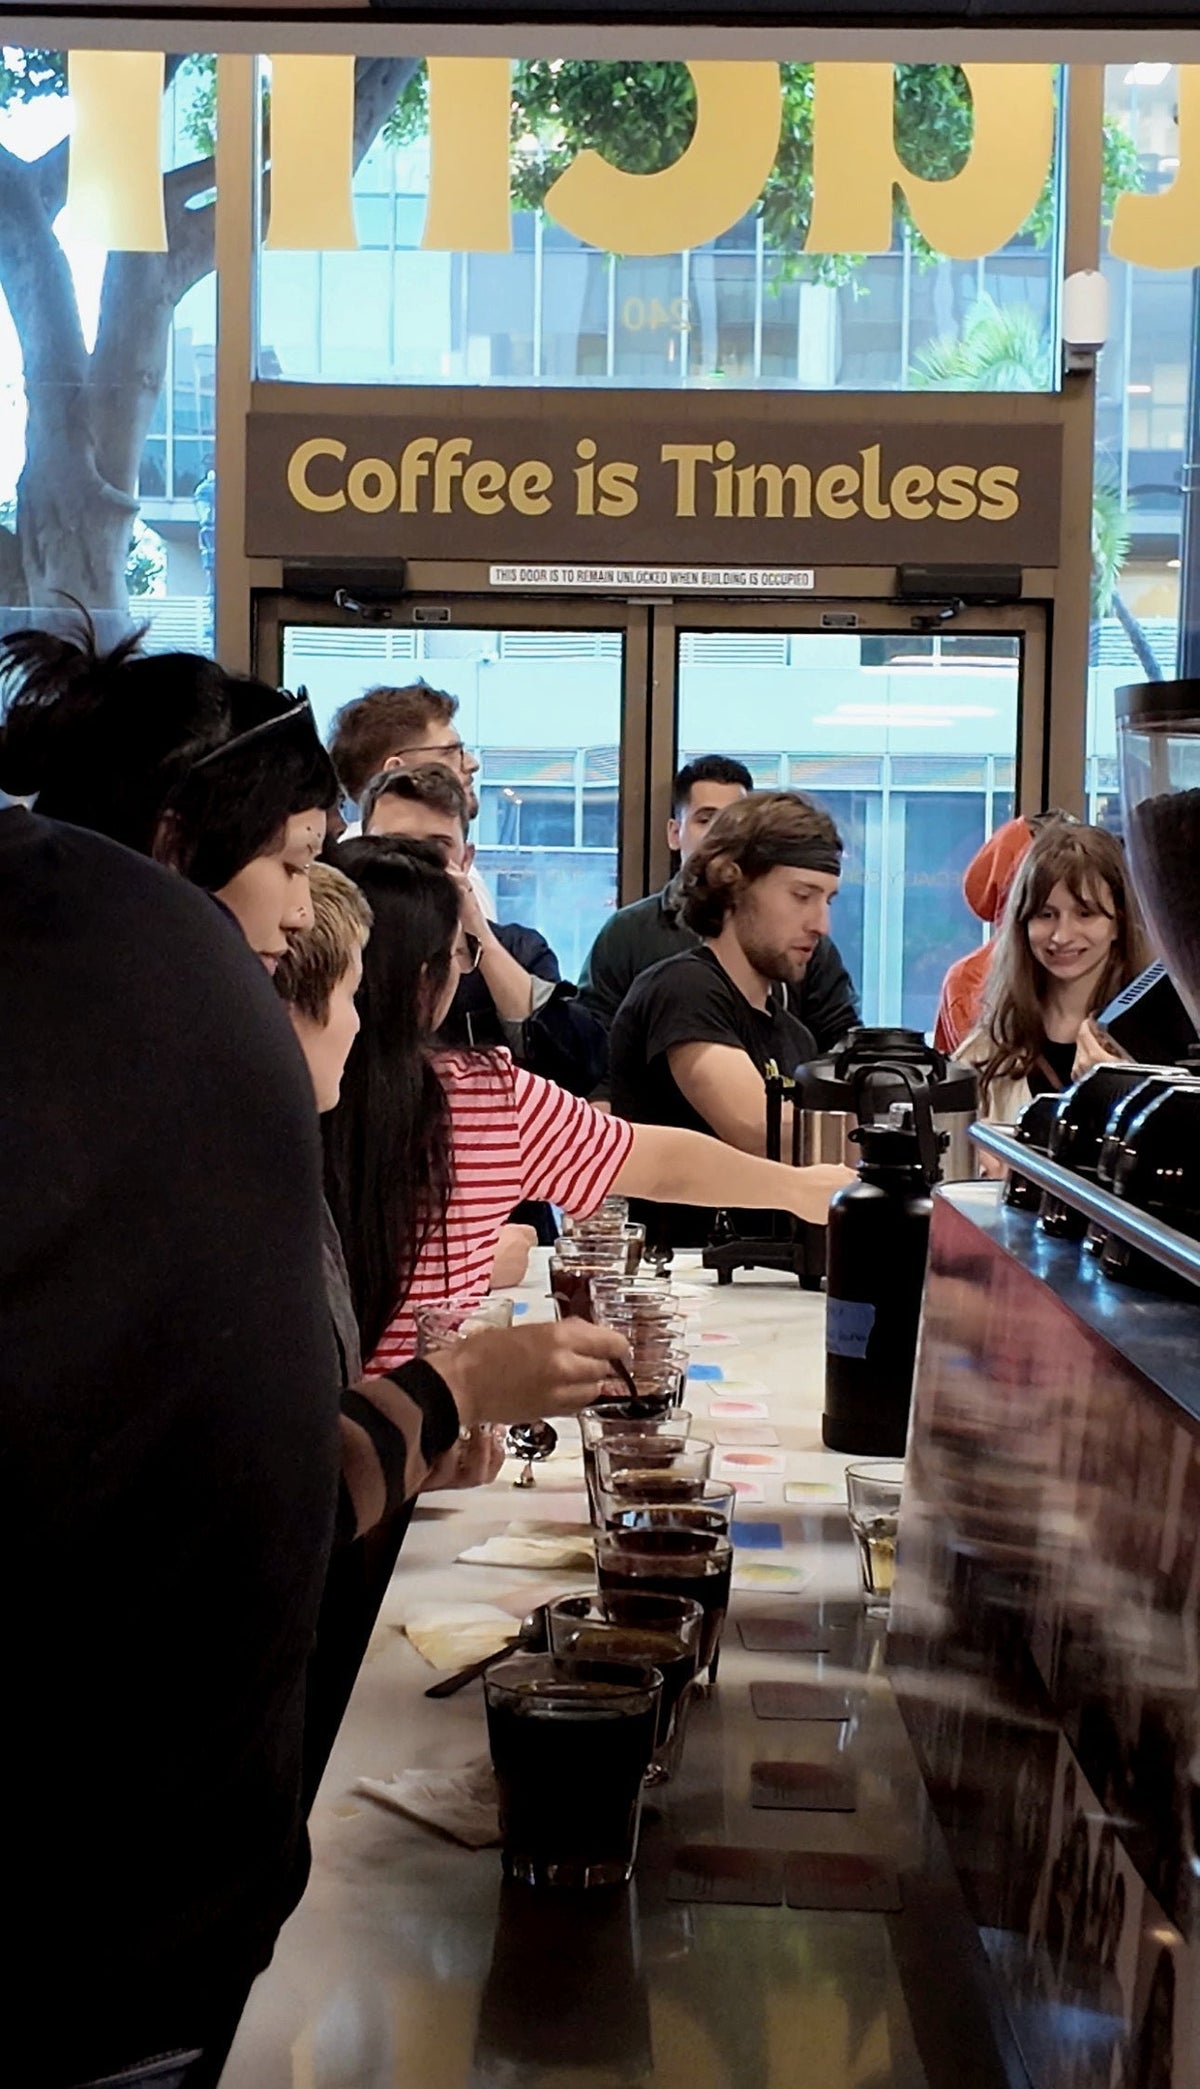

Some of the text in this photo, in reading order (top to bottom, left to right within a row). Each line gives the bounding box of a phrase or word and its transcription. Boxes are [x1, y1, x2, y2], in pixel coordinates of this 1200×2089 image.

[287, 437, 1019, 521] Coffee is Timeless
[495, 568, 809, 587] THIS DOOR IS TO REMAIN UNLOCKED WHEN BUILDING IS OCCUPIED
